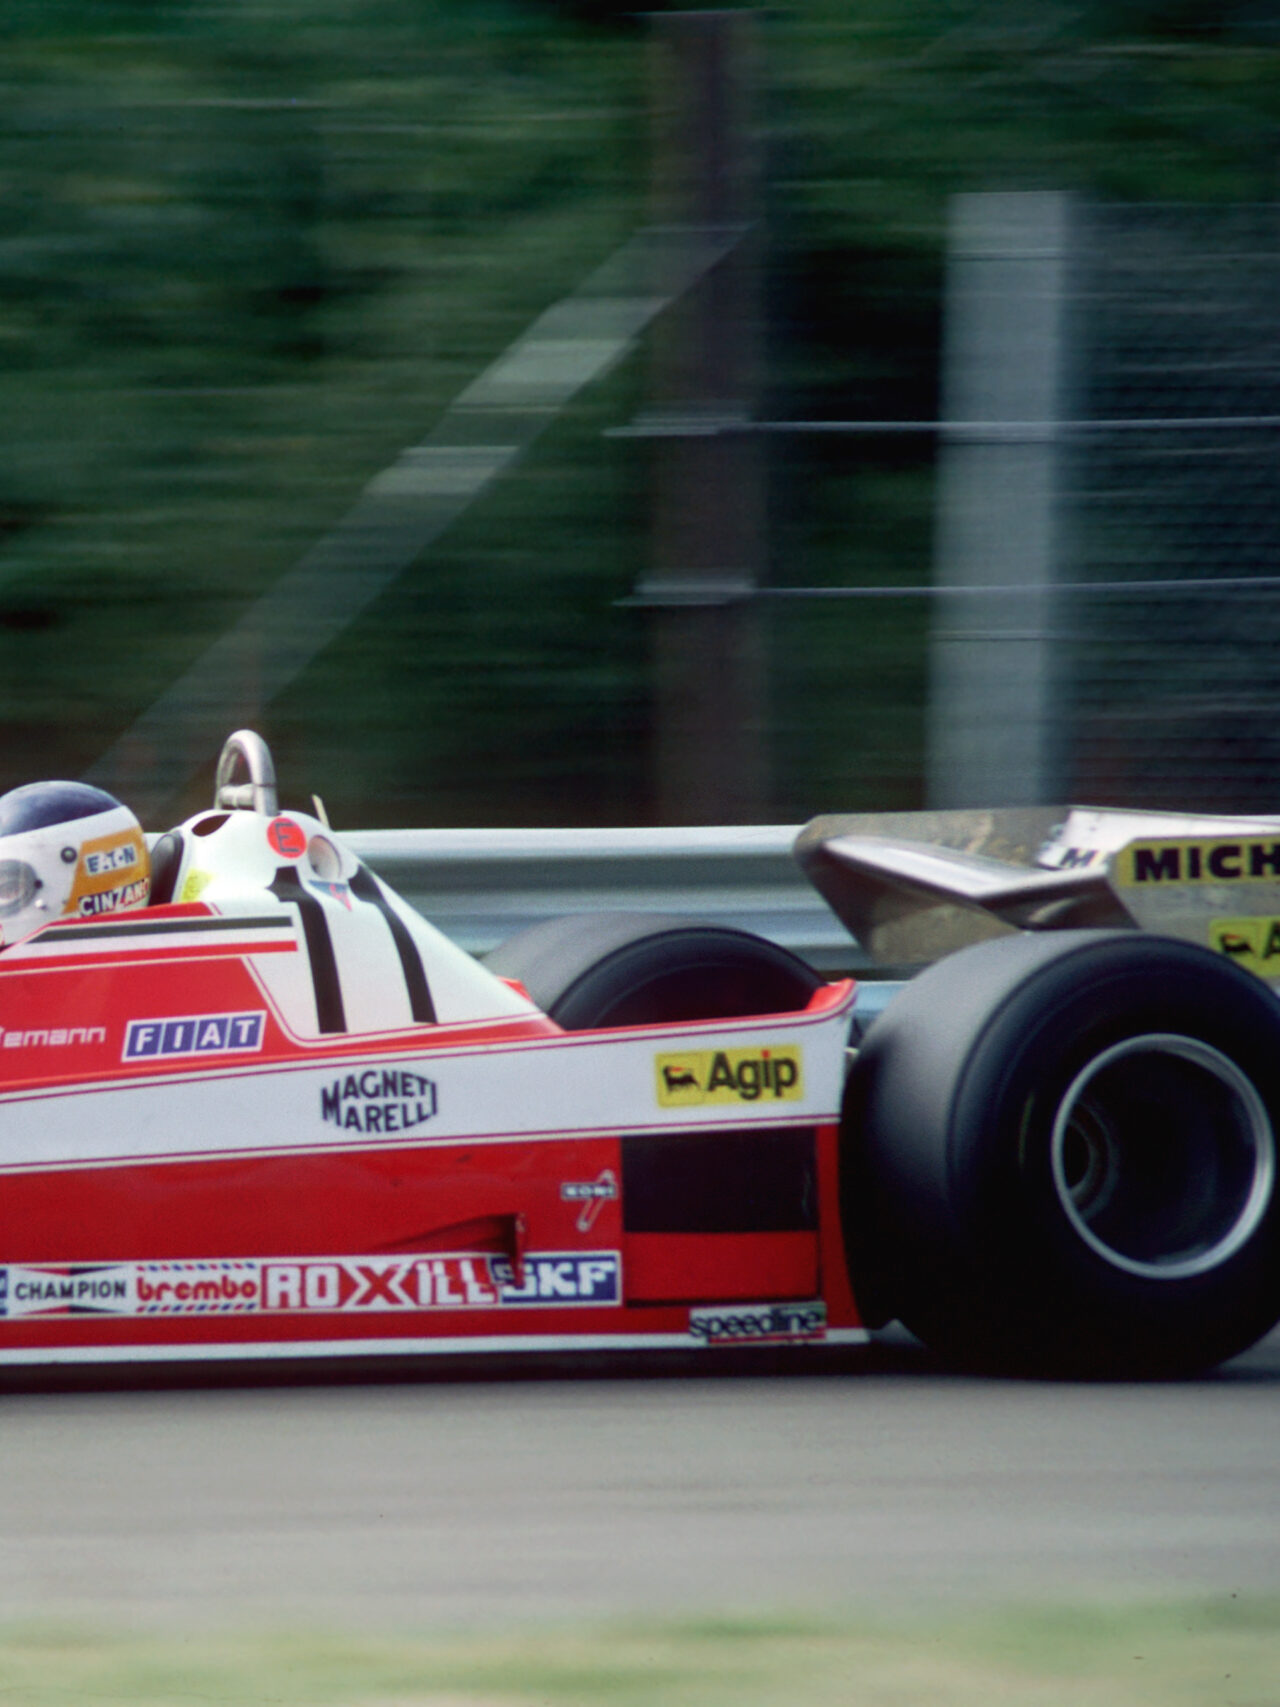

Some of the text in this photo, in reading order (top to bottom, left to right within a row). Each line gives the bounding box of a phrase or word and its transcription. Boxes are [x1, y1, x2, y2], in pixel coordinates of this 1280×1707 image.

[274, 821, 300, 853] E
[134, 1018, 256, 1054] FIAT
[706, 1050, 798, 1101] Agip
[15, 1279, 127, 1301] CHAMPION
[136, 1274, 258, 1302] brembo
